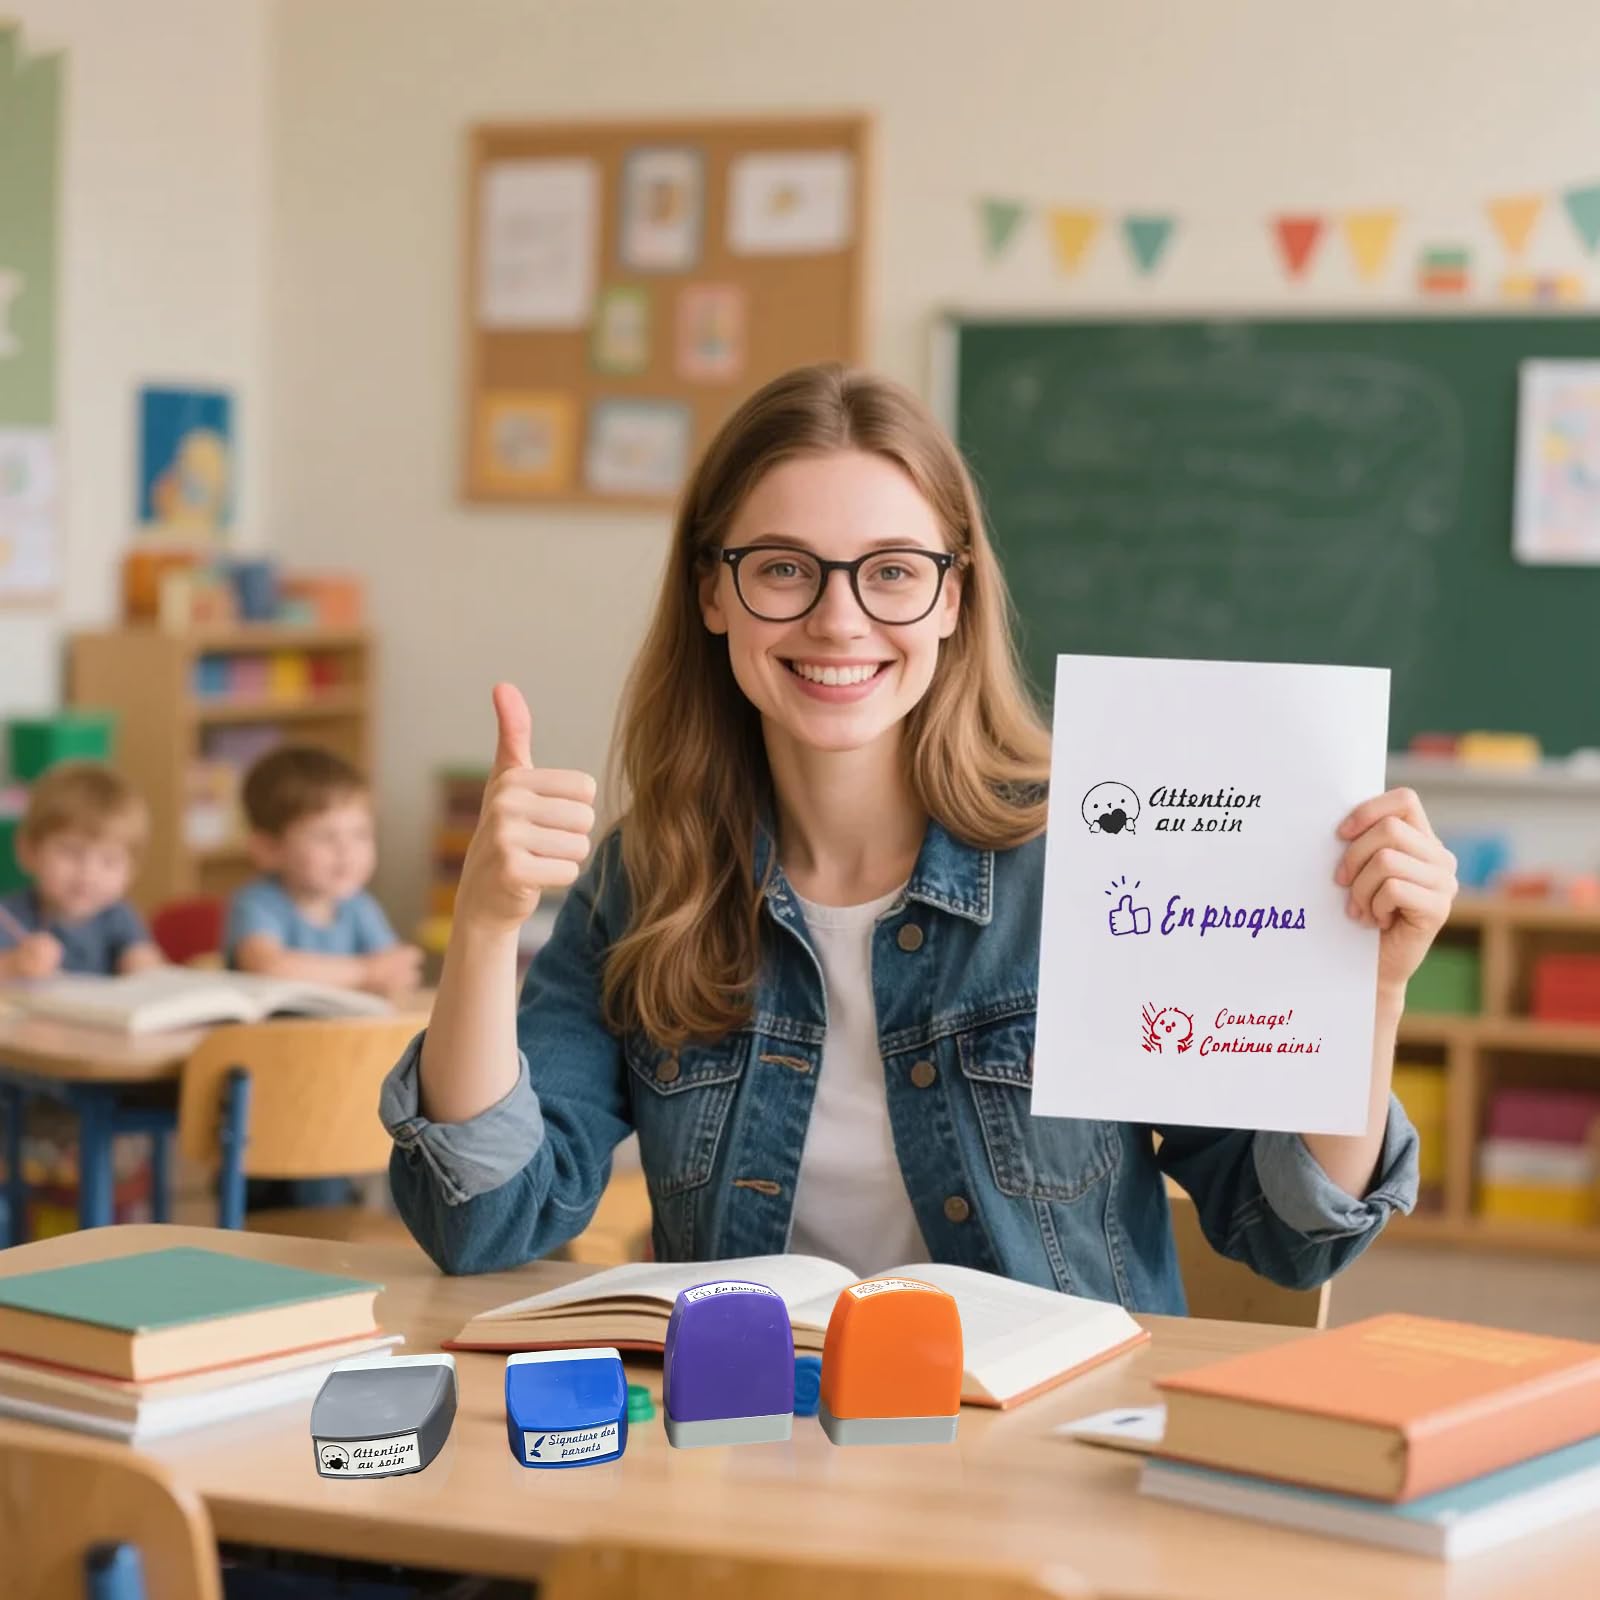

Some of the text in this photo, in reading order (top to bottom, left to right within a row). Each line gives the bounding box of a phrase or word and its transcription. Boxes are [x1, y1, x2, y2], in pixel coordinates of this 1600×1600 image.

[1148, 786, 1262, 808] Attention
[1155, 811, 1243, 832] au soin
[1160, 895, 1306, 938] En progres
[1215, 1008, 1293, 1030] Courage!
[1199, 1035, 1322, 1056] Continue ainsi
[548, 1426, 616, 1447] Signature des
[353, 1442, 414, 1458] Attention
[561, 1442, 601, 1458] parents
[358, 1455, 405, 1469] au soin
